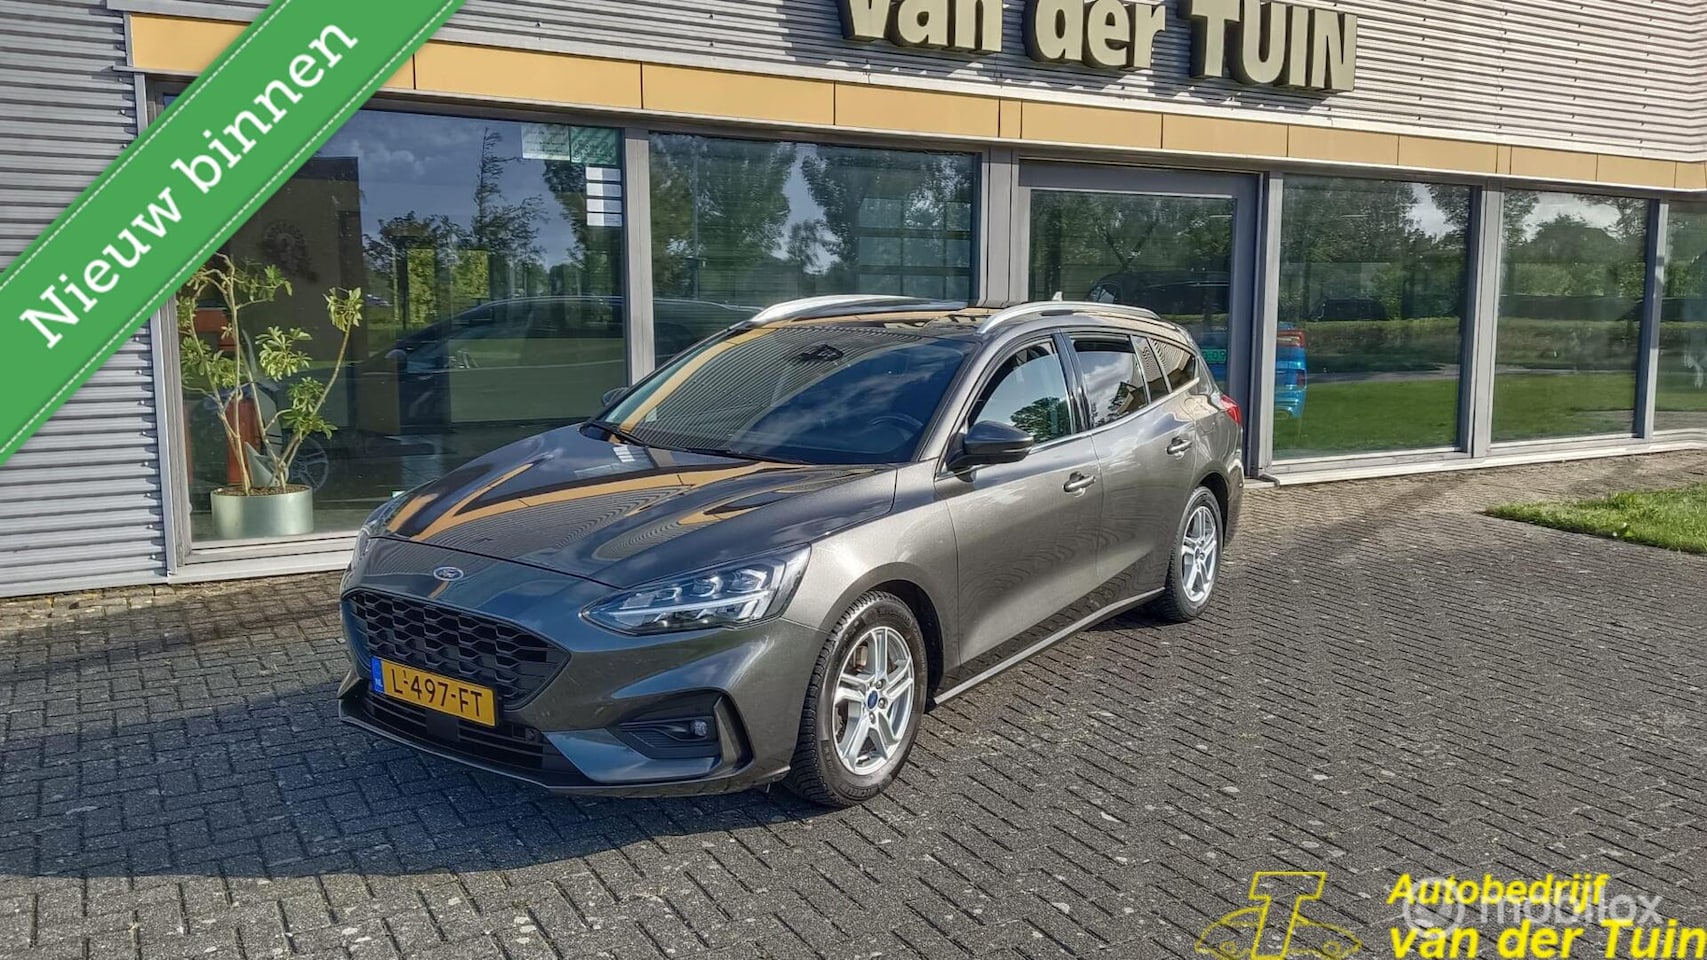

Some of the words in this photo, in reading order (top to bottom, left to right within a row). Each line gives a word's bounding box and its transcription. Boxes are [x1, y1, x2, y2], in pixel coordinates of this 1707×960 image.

[1035, 0, 1166, 69] der
[1191, 0, 1357, 91] TUIN
[391, 669, 482, 717] L-497-FT
